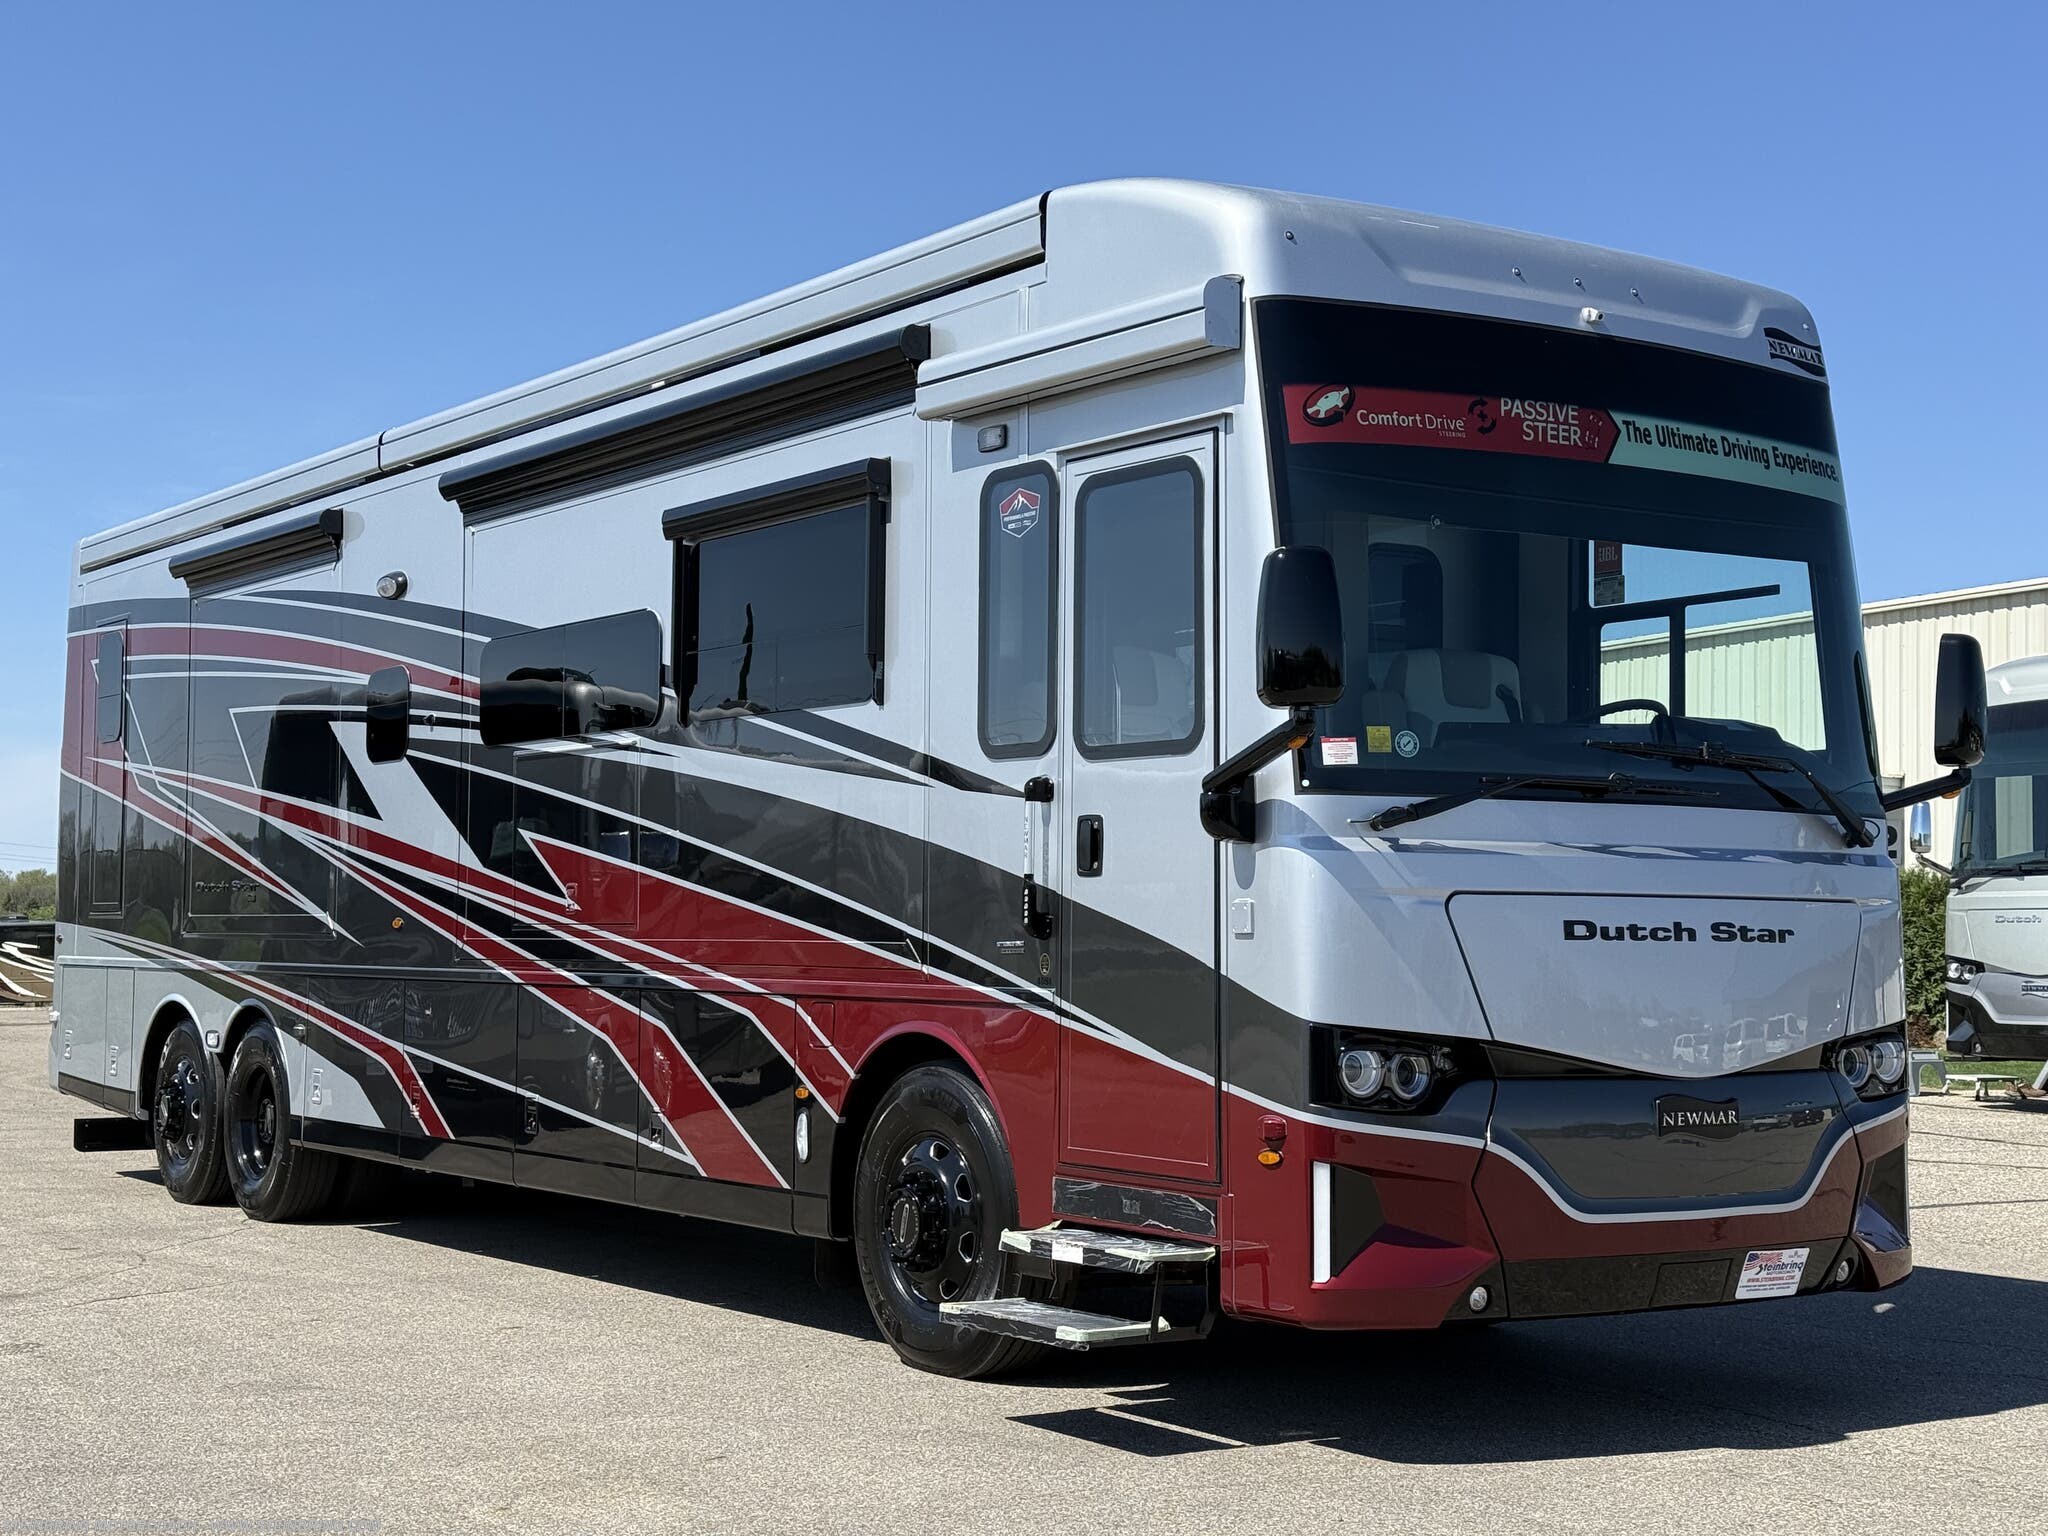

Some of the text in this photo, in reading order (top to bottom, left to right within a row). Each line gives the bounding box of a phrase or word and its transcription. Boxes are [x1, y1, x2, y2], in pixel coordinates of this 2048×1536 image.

[1356, 409, 1423, 428] Comfort
[1500, 397, 1580, 425] PASSIVE
[1522, 420, 1583, 447] STEER
[1622, 419, 1653, 446] The
[1655, 424, 1719, 456] Ultimate
[1720, 435, 1771, 470] Driving
[1995, 914, 2042, 924] Dutch
[1561, 919, 1796, 943] Dutch Star
[1662, 1110, 1738, 1127] NEWMAR
[1755, 1260, 1805, 1275] Steinbring
